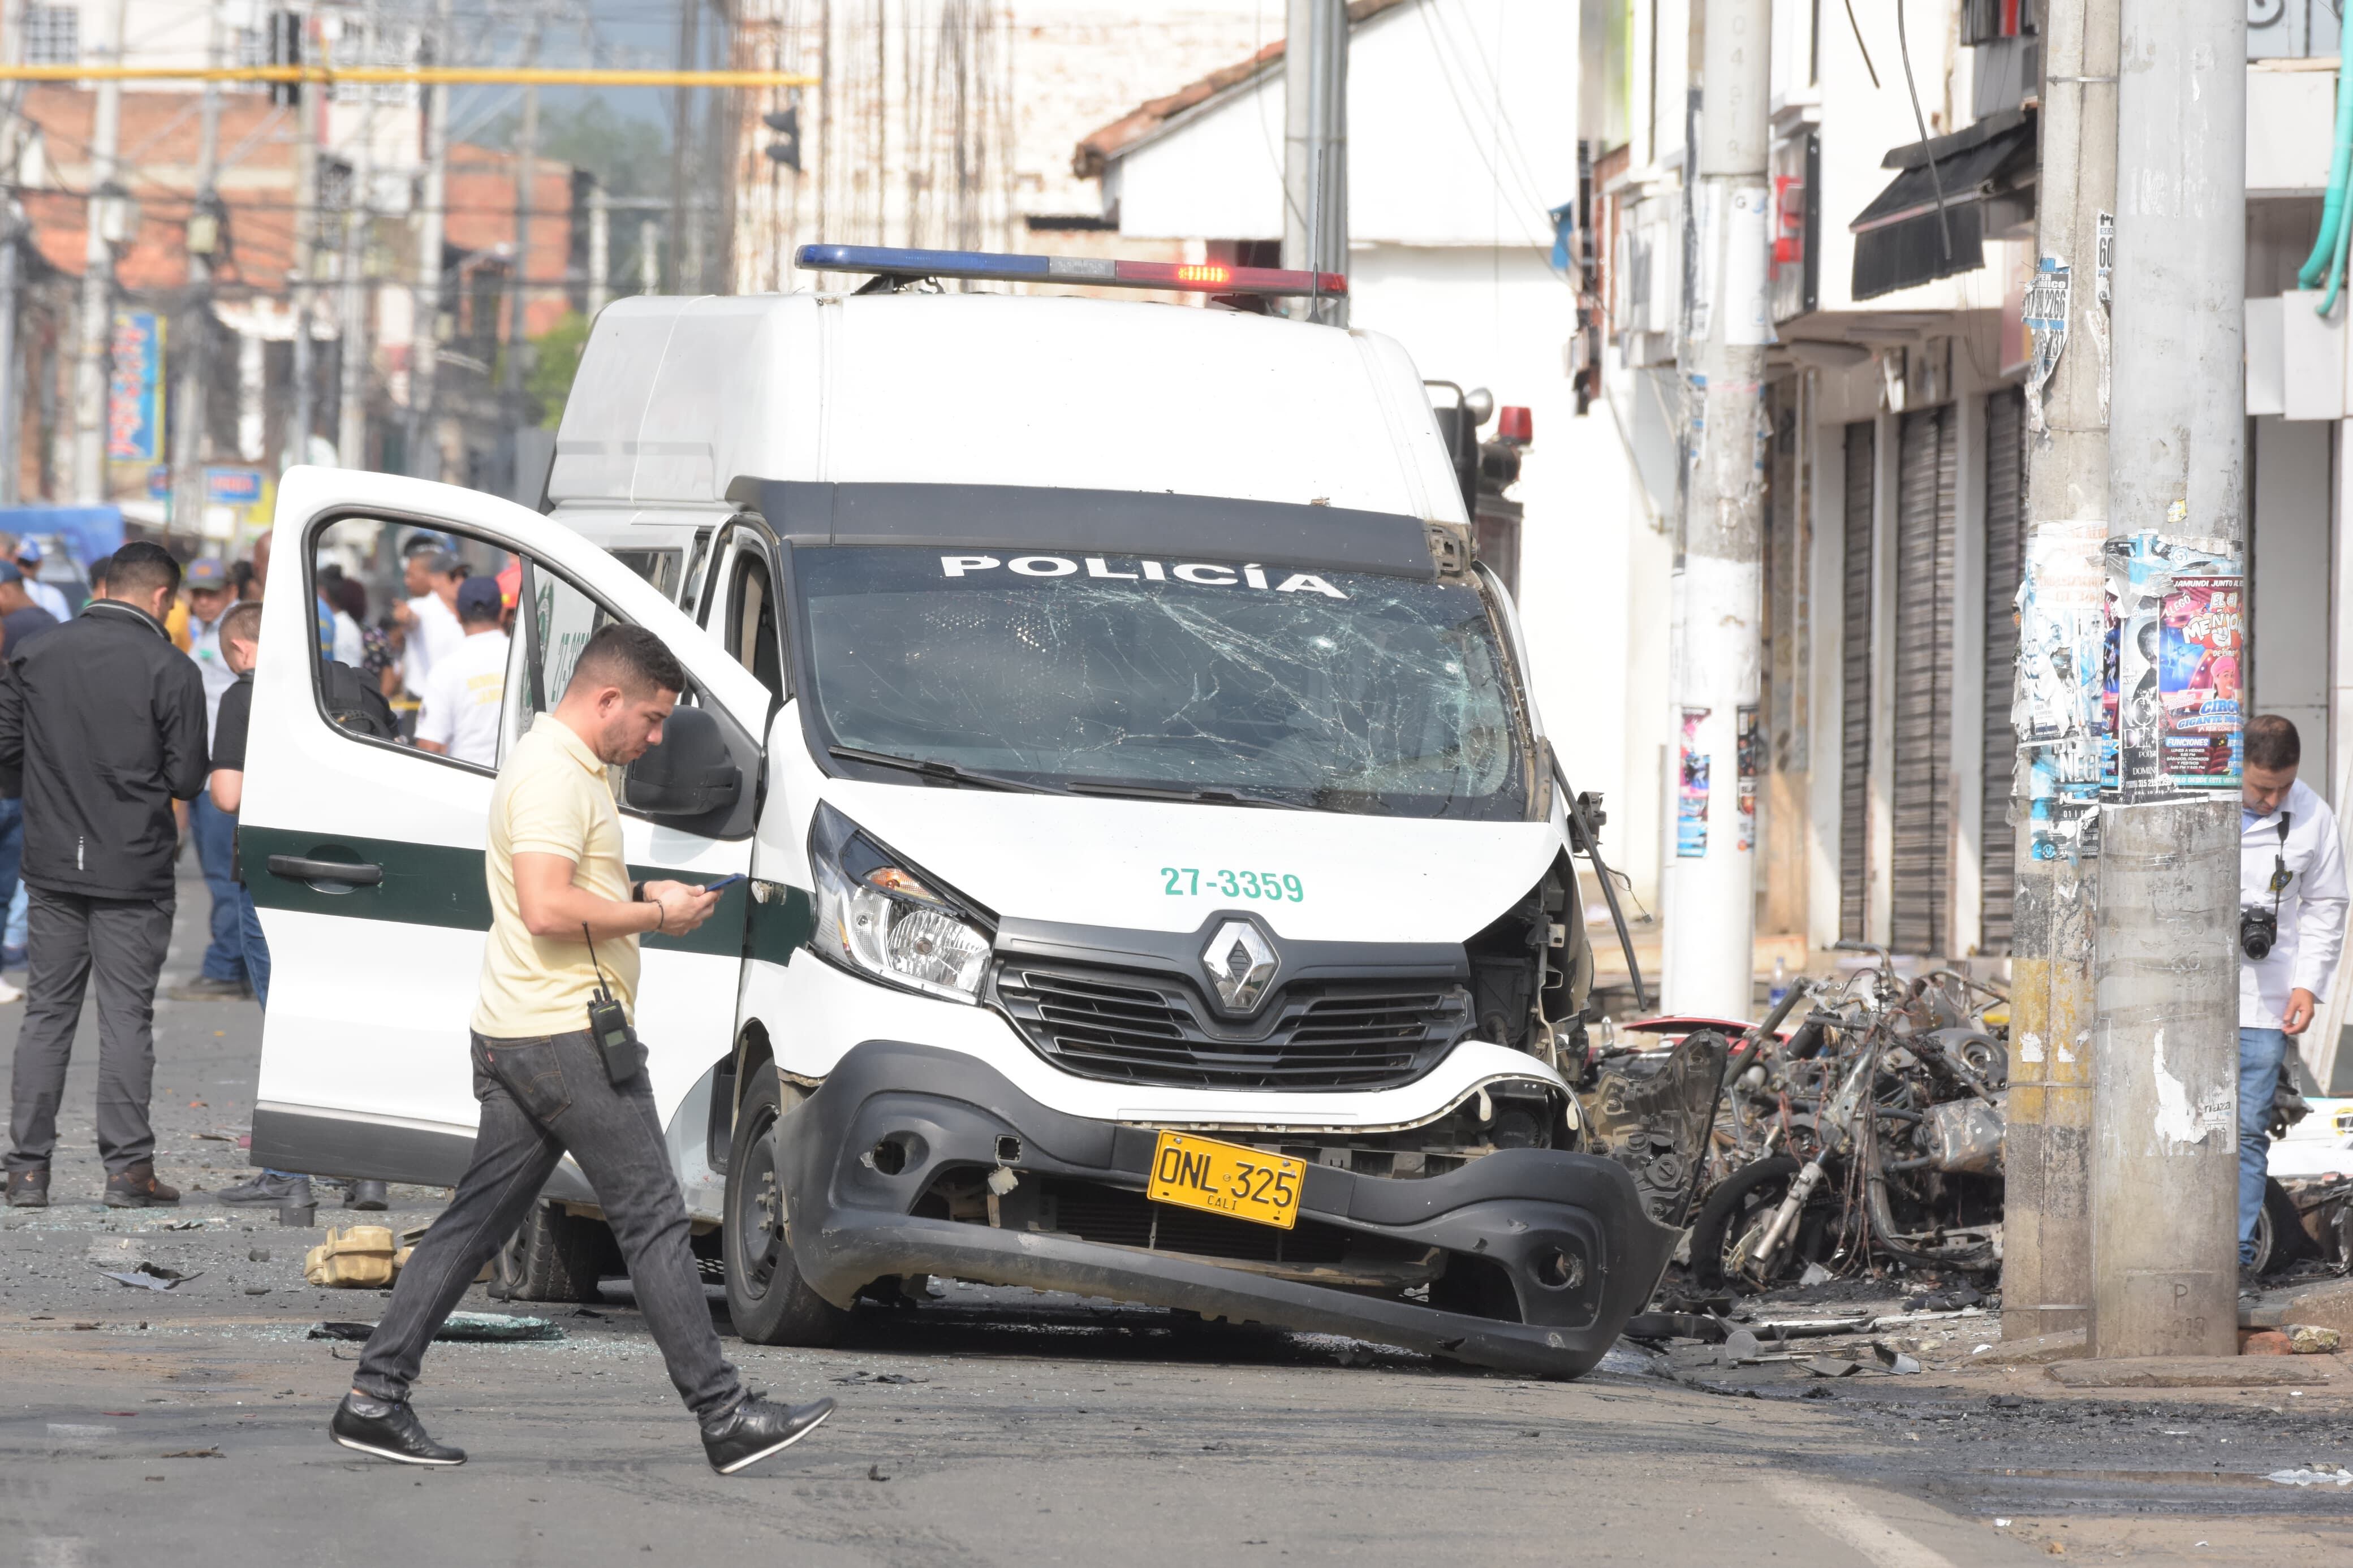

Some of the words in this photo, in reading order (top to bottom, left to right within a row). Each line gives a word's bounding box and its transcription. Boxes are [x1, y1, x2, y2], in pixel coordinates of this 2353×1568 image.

[2164, 593, 2191, 616] LLEGÓ
[2210, 592, 2226, 607] EL
[2177, 715, 2222, 729] GIGANTE
[1161, 867, 1304, 902] 27-3359
[1159, 1147, 1218, 1194] ONL
[1231, 1161, 1297, 1208] 325
[1208, 1194, 1238, 1211] CALI
